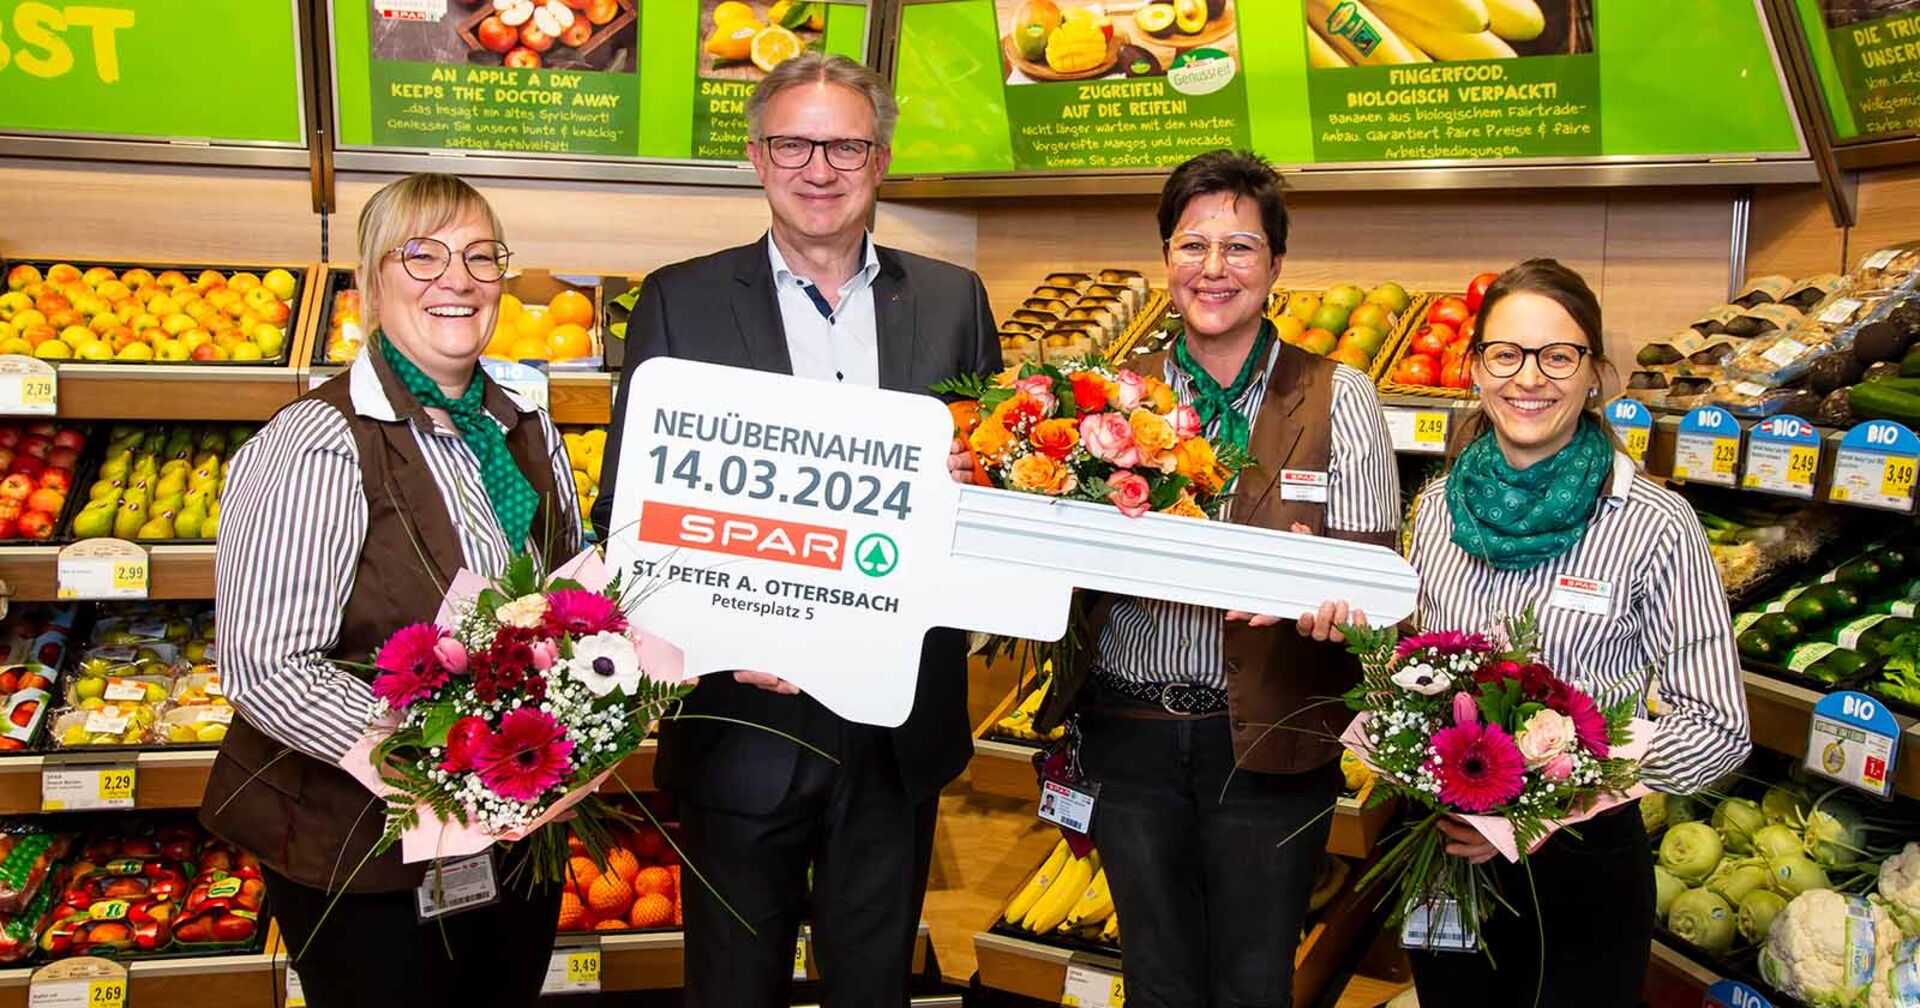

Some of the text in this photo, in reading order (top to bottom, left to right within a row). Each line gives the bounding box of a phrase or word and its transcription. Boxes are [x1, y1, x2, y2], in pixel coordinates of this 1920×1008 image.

[0, 0, 135, 83] ST
[1853, 25, 1882, 47] DIE
[432, 68, 582, 89] AN APPLE A DAY
[1390, 65, 1507, 85] FINGERFOOD.
[391, 83, 620, 109] KEEPS THE DOCTOR AWAY
[1079, 82, 1164, 100] ZUGREIFEN
[1347, 82, 1557, 108] BIOLOGISCH VERPACKT!
[710, 99, 744, 114] DEM
[1062, 101, 1187, 119] AUF DIE REIFEN!
[1328, 112, 1383, 125] Bananen
[1388, 112, 1411, 123] aus
[1416, 105, 1503, 124] biologischem
[1095, 120, 1137, 132] warten
[1141, 118, 1160, 131] mit
[1164, 118, 1186, 130] den
[1365, 126, 1441, 141] Garantiert
[1445, 125, 1480, 139] faire
[1486, 124, 1532, 138] Preise
[1552, 122, 1591, 135] faire
[1104, 137, 1147, 152] Mangos
[1151, 135, 1172, 148] und
[1177, 134, 1232, 146] Avocados
[1110, 152, 1150, 166] sofort
[1615, 403, 1637, 420] BIO
[1698, 410, 1722, 427] BIO
[1773, 419, 1800, 437] BIO
[1867, 424, 1899, 445] BIO
[653, 407, 922, 473] NEUÜBERNAHME
[649, 445, 912, 521] 14.03.2024
[679, 513, 839, 563] SPAR
[632, 560, 899, 613] ST. PETER A. OTTERSBACH
[712, 593, 814, 620] Petersplatz 5
[1843, 695, 1875, 720] BIO
